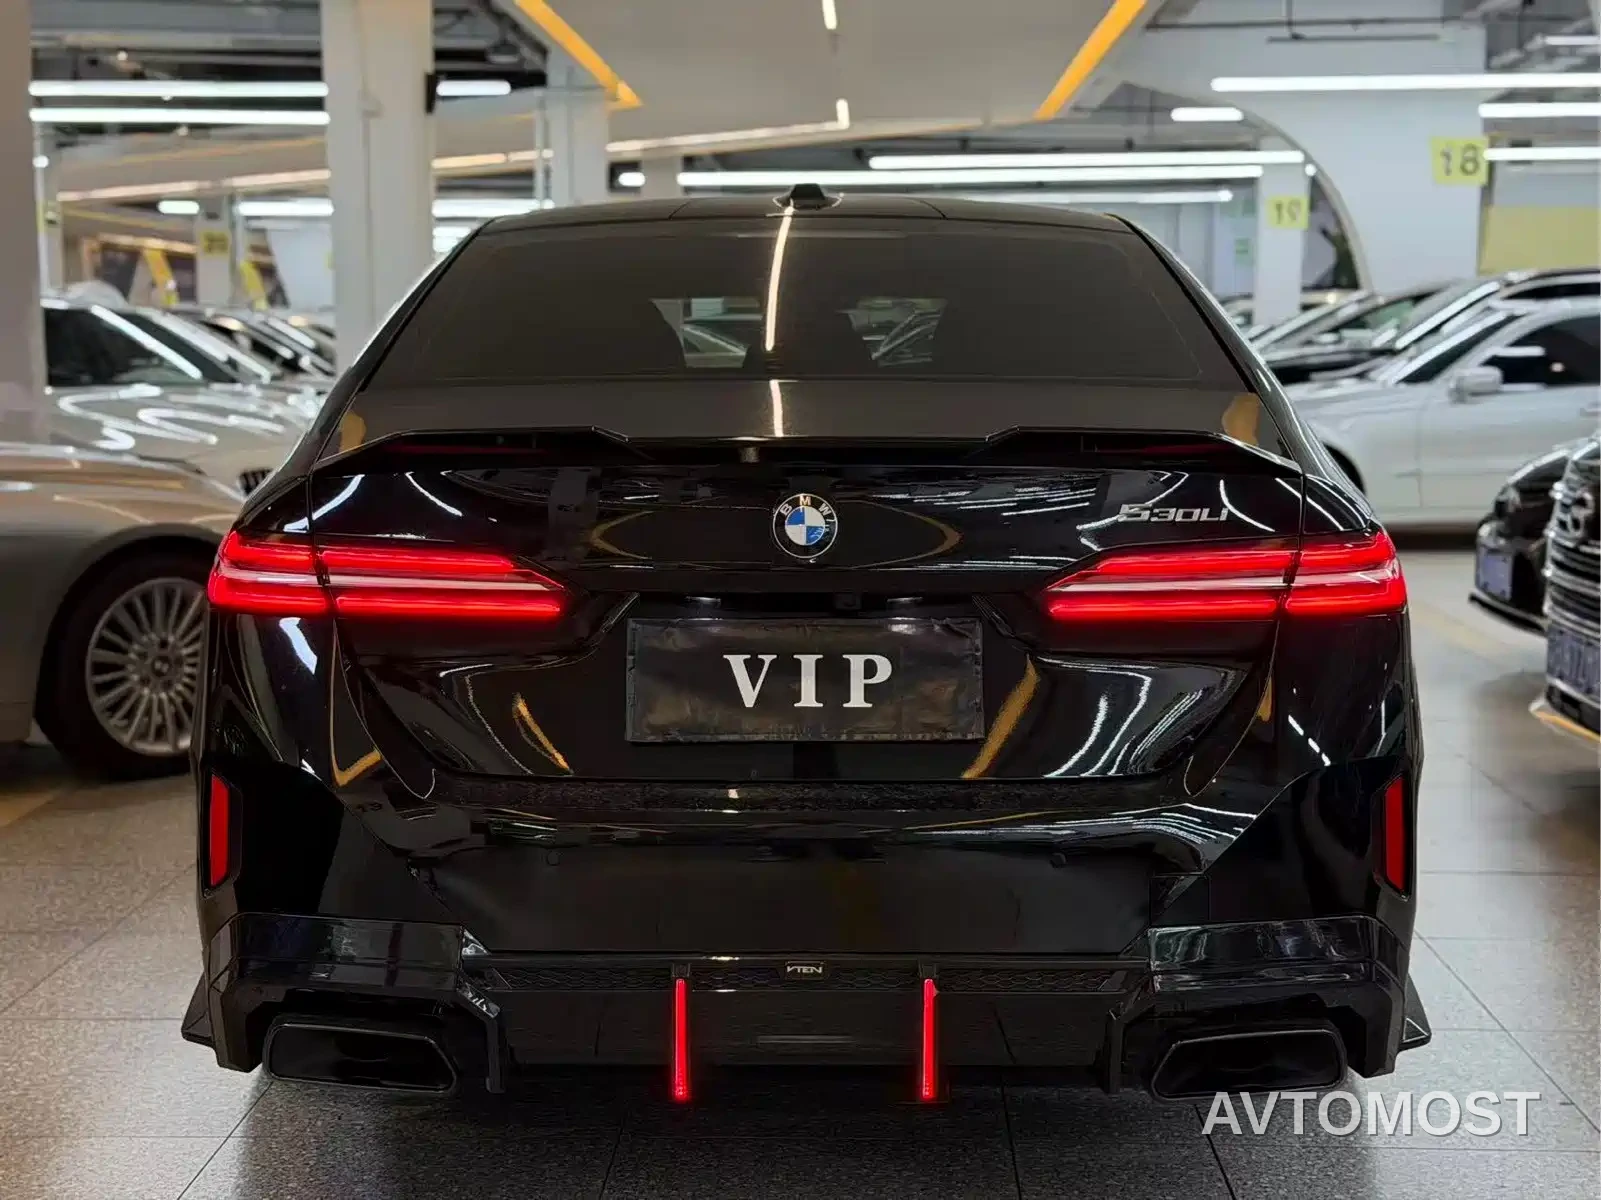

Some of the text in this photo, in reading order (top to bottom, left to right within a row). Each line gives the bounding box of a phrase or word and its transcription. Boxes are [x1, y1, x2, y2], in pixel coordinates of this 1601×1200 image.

[1439, 143, 1480, 177] 18
[779, 495, 832, 516] BMW
[722, 653, 893, 708] VIP
